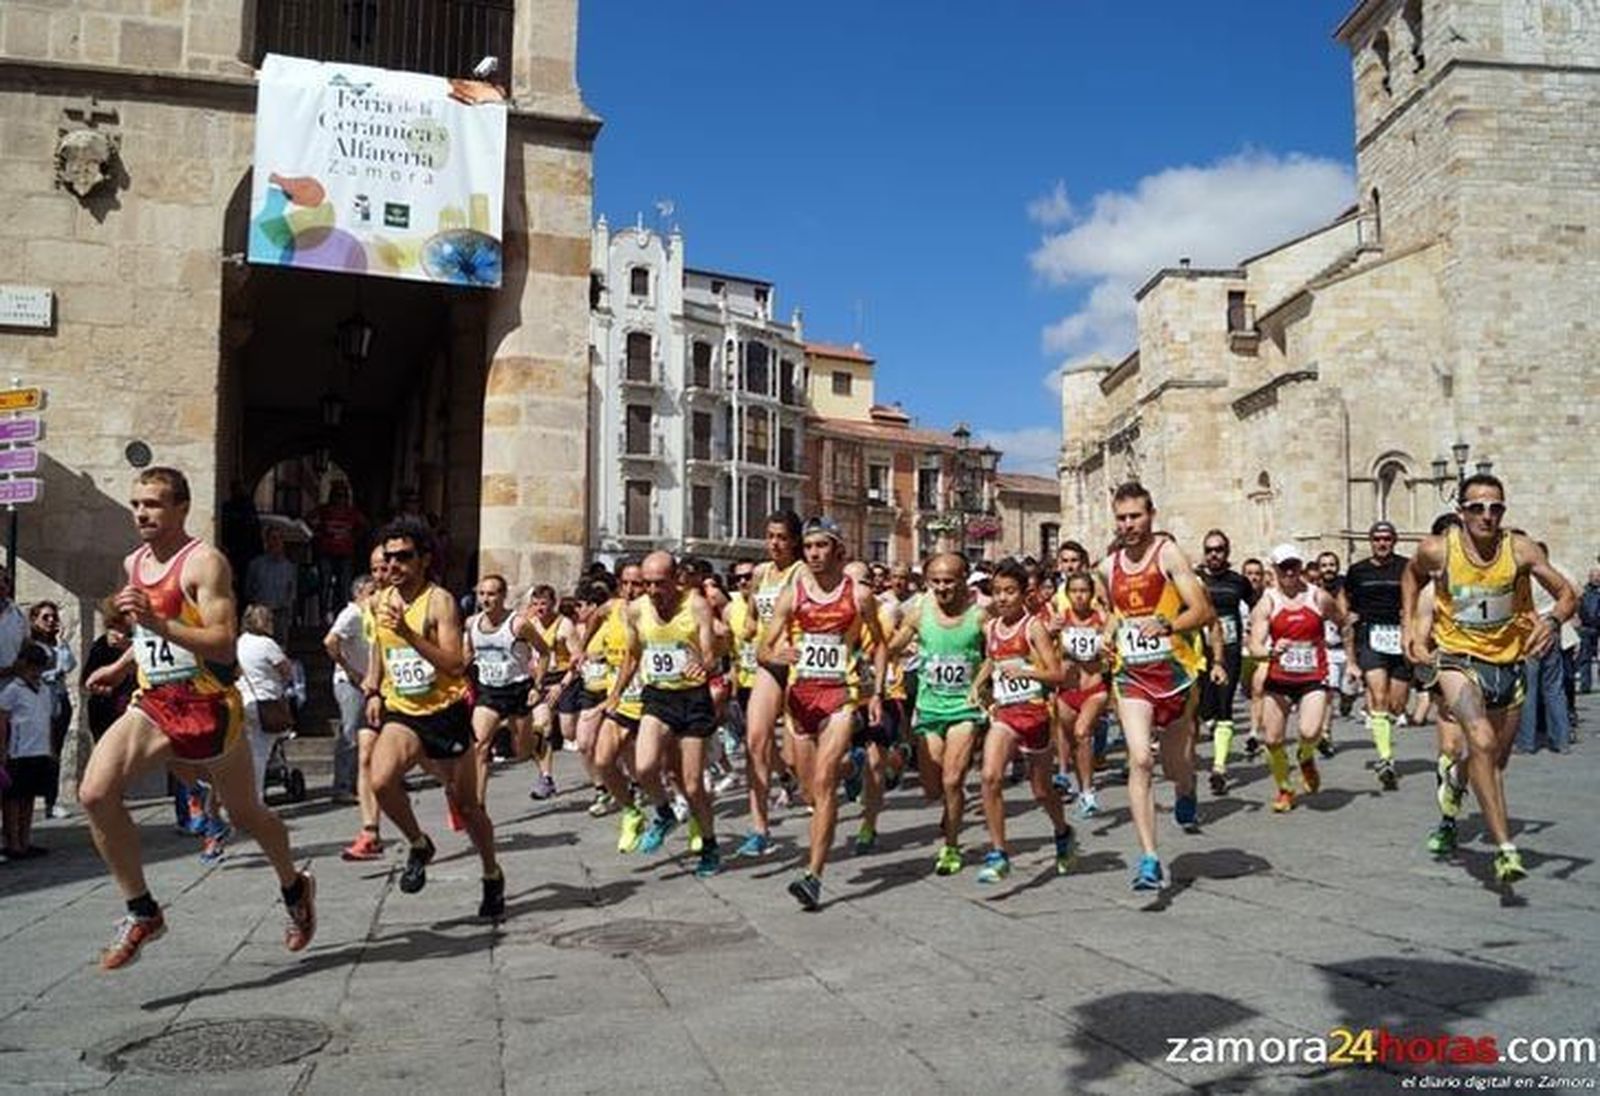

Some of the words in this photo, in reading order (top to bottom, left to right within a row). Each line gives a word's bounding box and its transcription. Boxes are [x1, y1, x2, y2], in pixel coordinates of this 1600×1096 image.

[336, 88, 392, 113] Feria
[327, 158, 434, 185] Zamora
[1478, 600, 1488, 619] 1
[145, 640, 175, 668] 74
[1071, 637, 1096, 653] 191
[652, 653, 673, 672] 99
[805, 646, 838, 668] 200
[935, 666, 964, 683] 102
